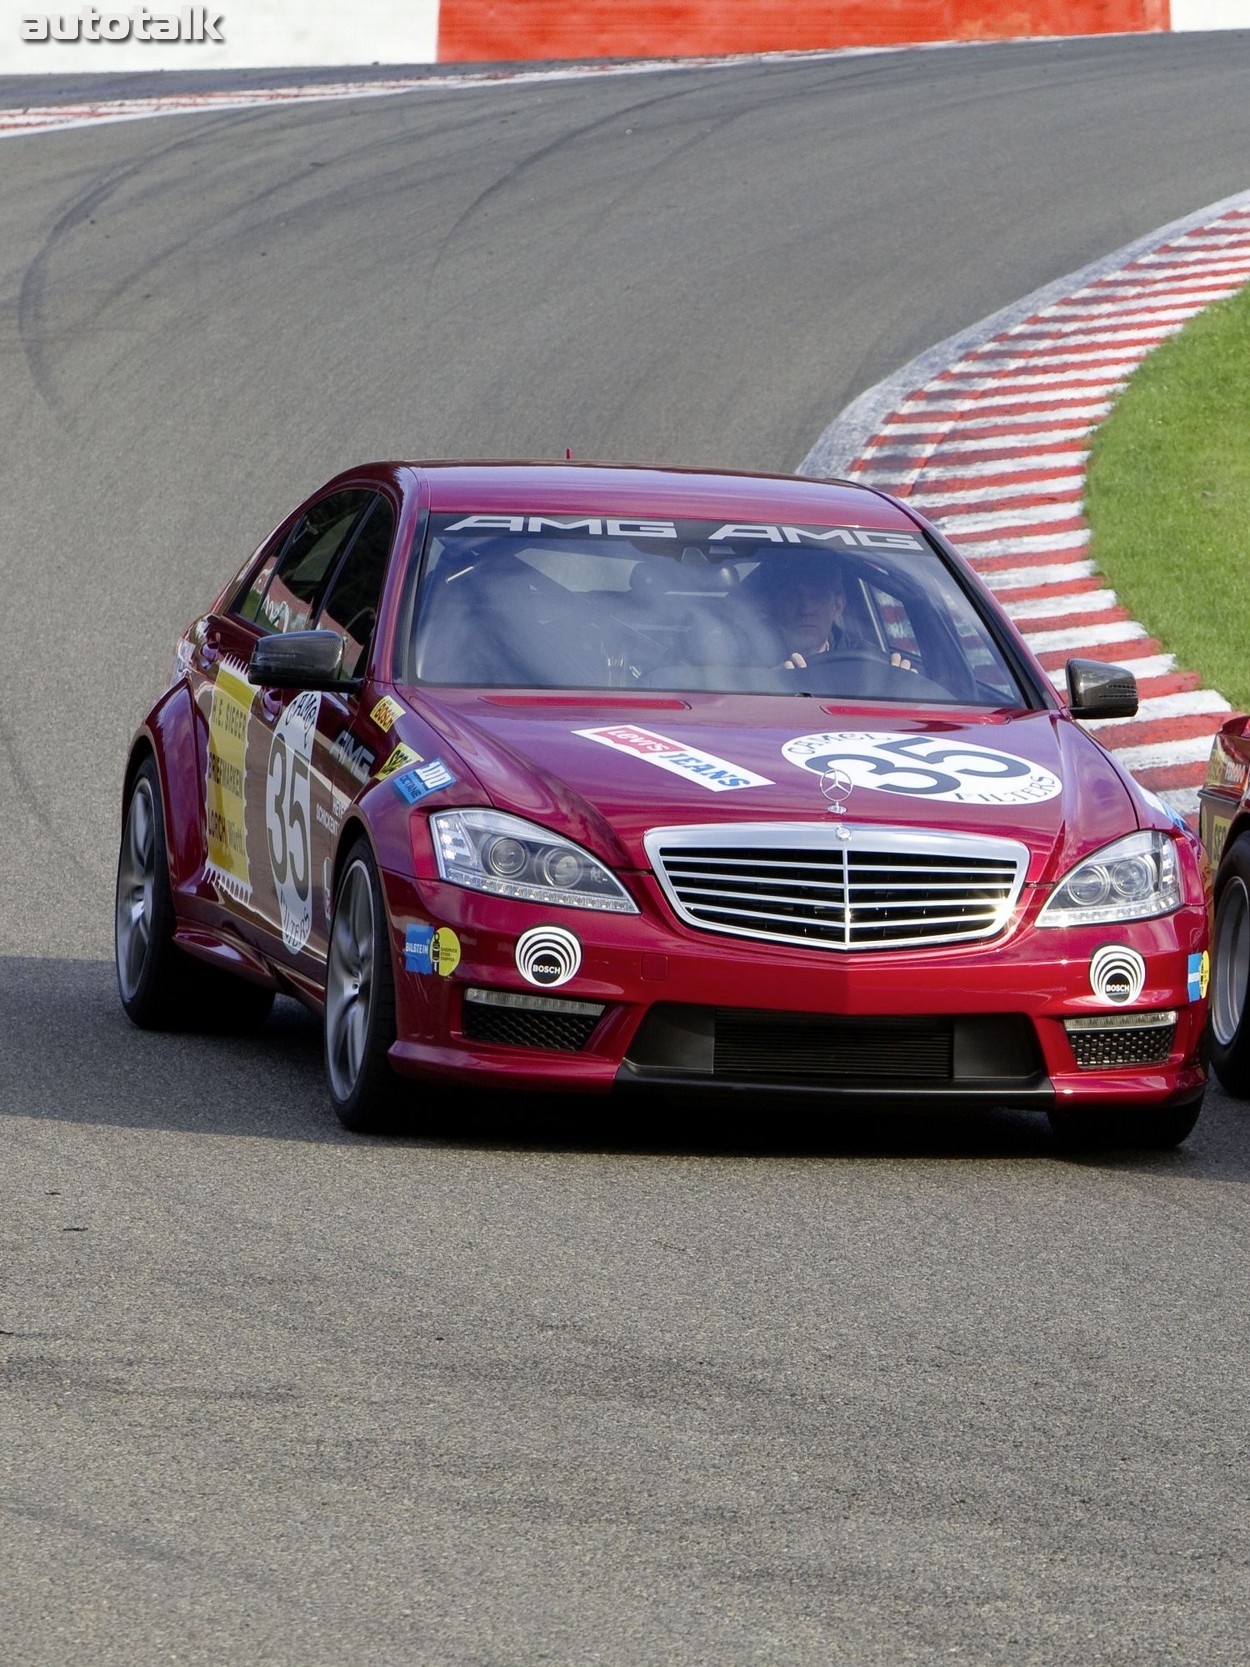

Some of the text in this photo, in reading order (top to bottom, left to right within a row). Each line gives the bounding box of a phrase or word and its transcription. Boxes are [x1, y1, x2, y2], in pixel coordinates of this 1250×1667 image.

[444, 515, 924, 552] AMG AMG
[328, 729, 376, 785] AMG
[786, 732, 892, 756] CAMEL
[414, 759, 453, 790] 100
[657, 751, 751, 788] JEANS
[804, 736, 1032, 795] 35
[953, 774, 1057, 803] FILTERS
[266, 732, 311, 902] 35
[405, 942, 430, 955] BILSTEIN
[532, 963, 561, 976] BOSCH
[1105, 984, 1131, 993] BOSCH
